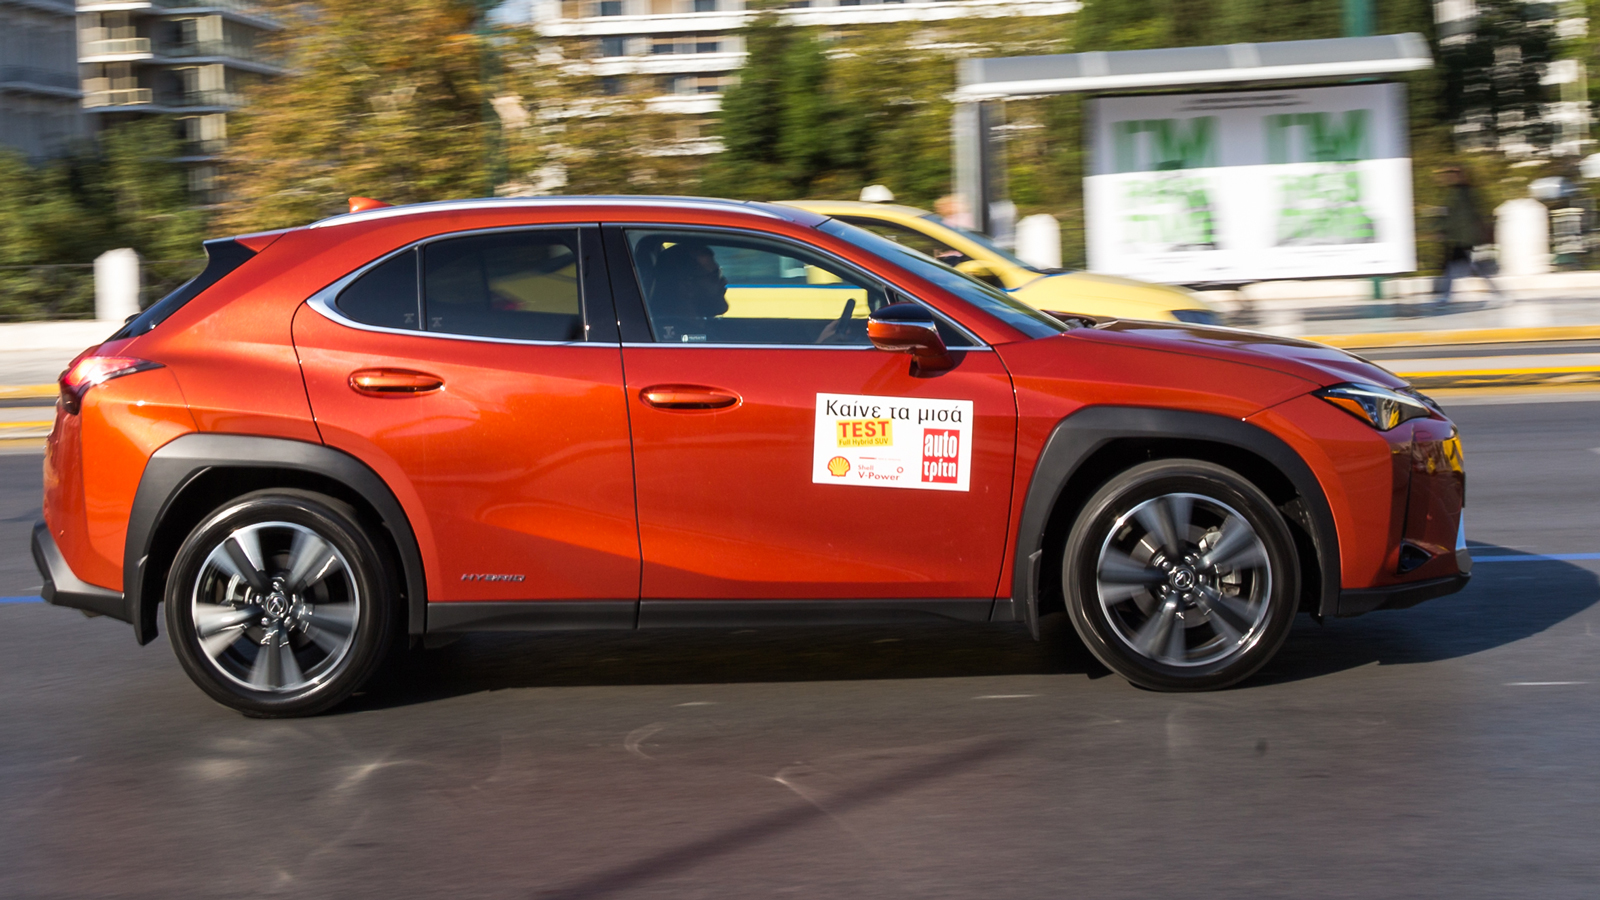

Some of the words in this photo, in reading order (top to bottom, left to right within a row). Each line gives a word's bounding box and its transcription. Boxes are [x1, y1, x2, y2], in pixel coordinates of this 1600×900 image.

[826, 399, 882, 419] Καίνε
[889, 406, 910, 420] τα
[918, 405, 963, 425] μισά
[838, 420, 889, 438] TEST
[852, 438, 873, 447] Hybrid
[924, 430, 958, 458] auto
[858, 471, 901, 482] V-Power
[923, 458, 957, 482] τρίτη
[461, 573, 527, 582] HYBRID
